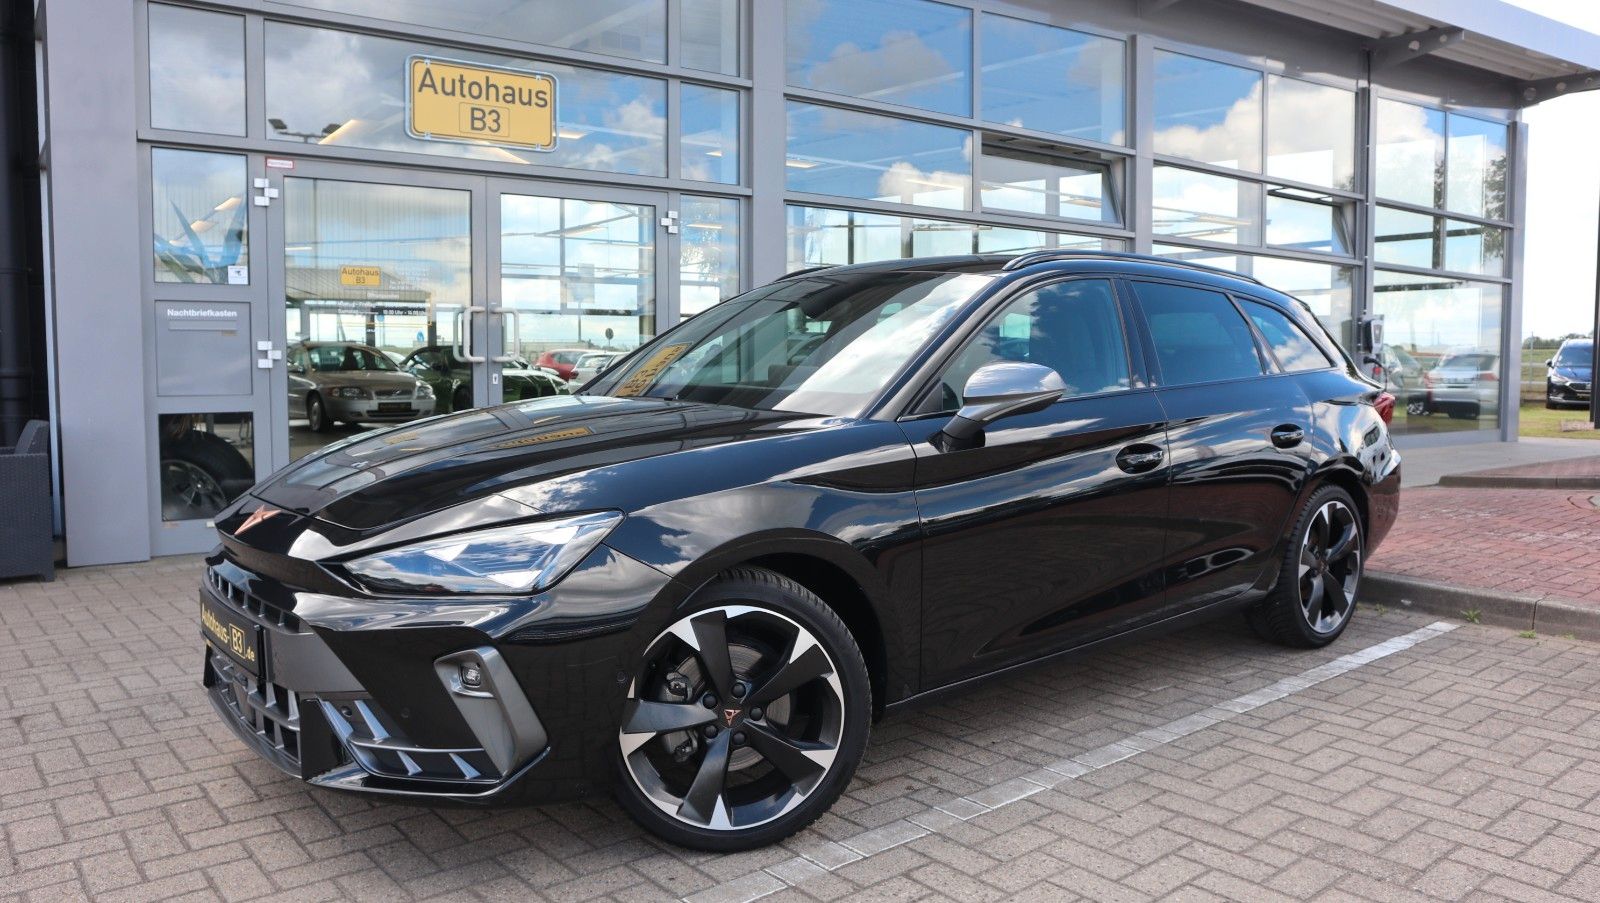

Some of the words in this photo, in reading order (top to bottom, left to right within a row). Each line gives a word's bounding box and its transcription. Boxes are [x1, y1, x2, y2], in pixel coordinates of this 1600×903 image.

[418, 67, 548, 108] Autohaus
[470, 107, 501, 133] B3
[342, 268, 379, 276] Autohaus
[167, 308, 238, 317] Nachtbriefkasten
[231, 627, 243, 653] B3
